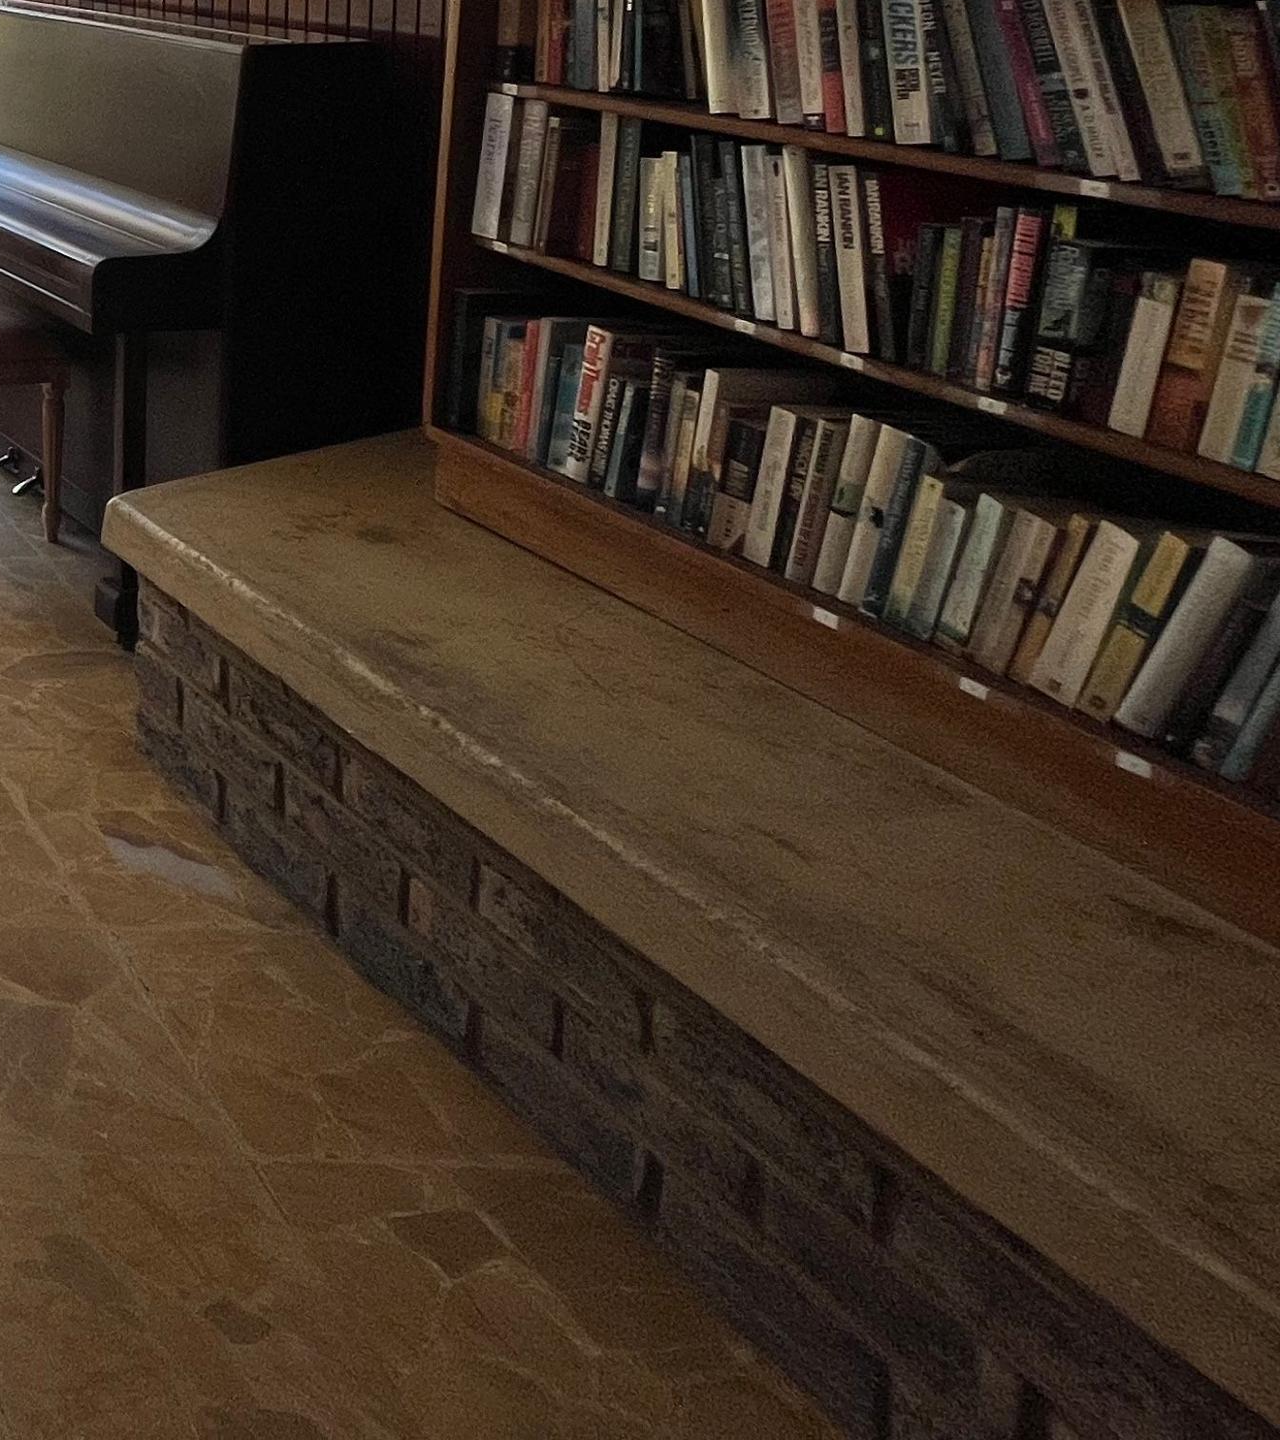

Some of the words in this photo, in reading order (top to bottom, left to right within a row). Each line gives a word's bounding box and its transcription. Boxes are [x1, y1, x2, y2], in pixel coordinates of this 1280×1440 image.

[925, 51, 946, 96] MEYER
[814, 165, 828, 189] IAN
[837, 172, 849, 196] IAN
[865, 180, 881, 202] IAN
[815, 189, 831, 242] RANKIN
[840, 198, 854, 249] RANKIN
[868, 203, 885, 254] RANKIN
[1033, 347, 1054, 374] FOR
[1045, 351, 1071, 403] BLEED
[595, 410, 612, 452] THOMAS
